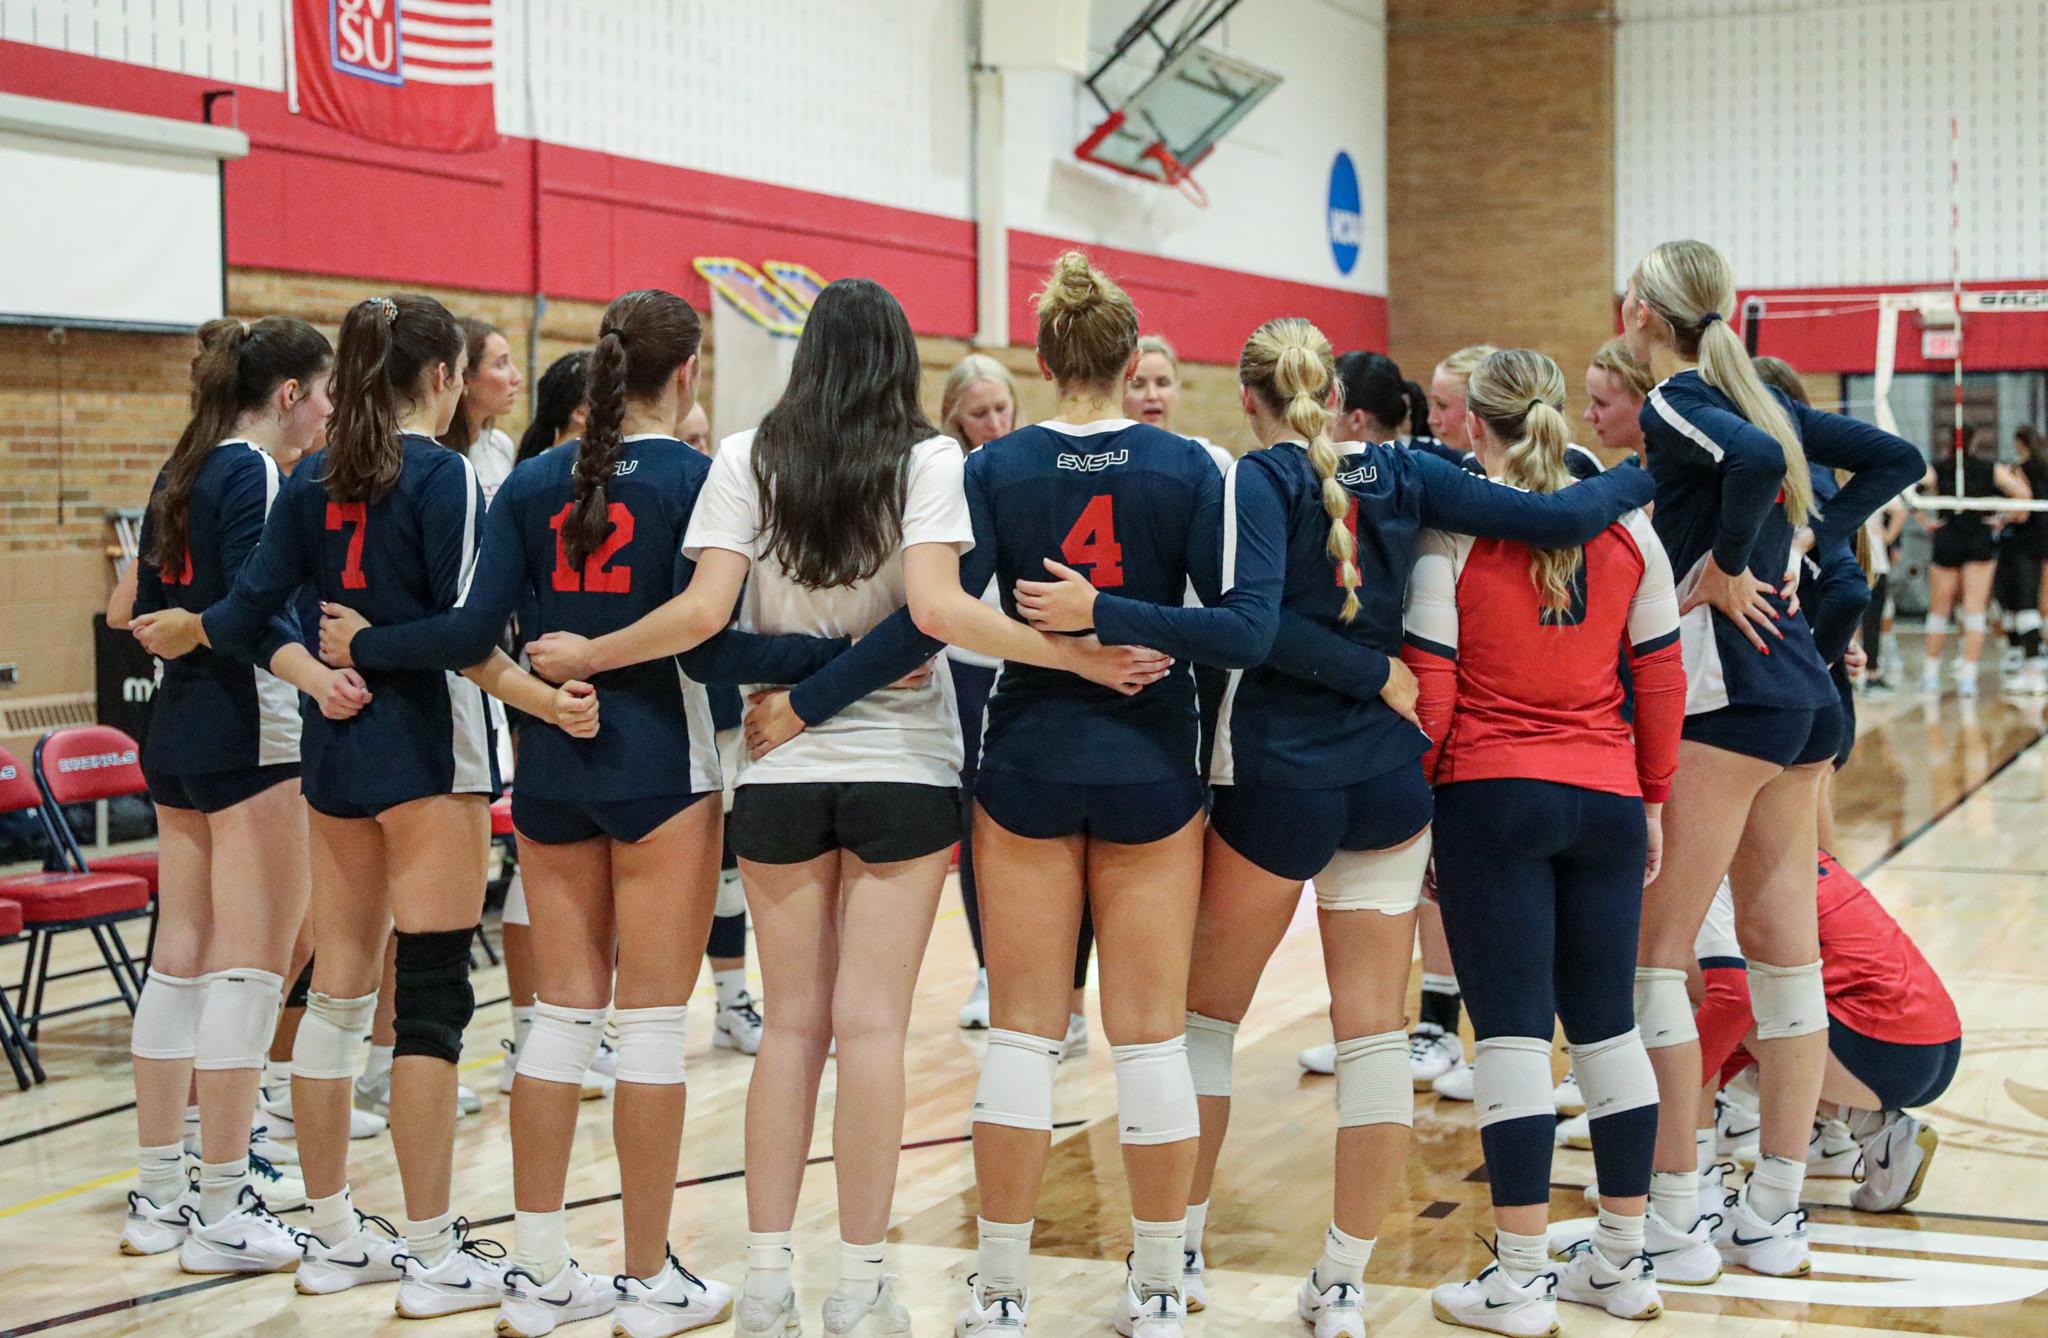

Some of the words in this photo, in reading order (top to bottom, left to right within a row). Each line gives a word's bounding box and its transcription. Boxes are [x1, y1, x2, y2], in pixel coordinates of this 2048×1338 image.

[339, 10, 394, 71] SU
[1057, 449, 1128, 472] SVSU
[325, 500, 367, 589] 7
[549, 502, 636, 594] 12
[1060, 494, 1124, 587] 4
